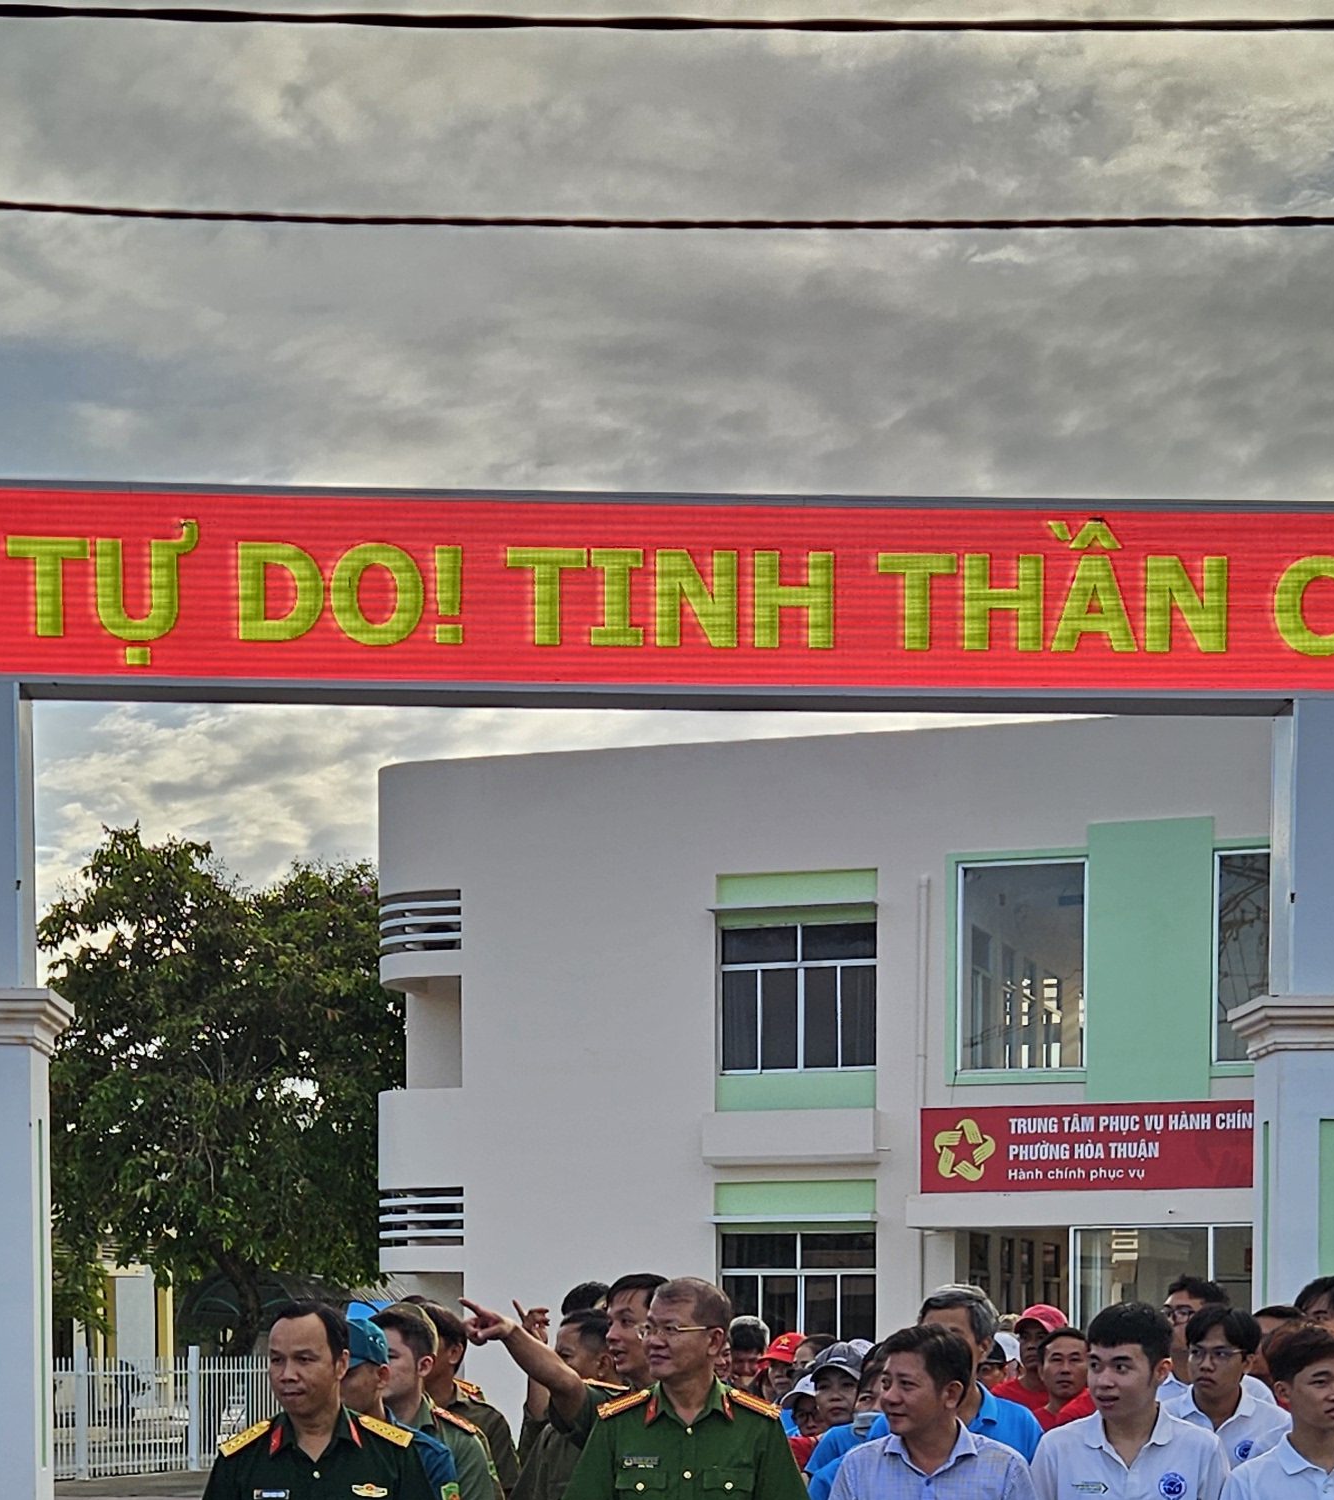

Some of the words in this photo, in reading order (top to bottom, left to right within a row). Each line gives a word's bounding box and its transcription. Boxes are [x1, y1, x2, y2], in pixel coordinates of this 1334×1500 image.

[6, 518, 199, 665] TỰ
[237, 541, 463, 645] DO!
[506, 546, 835, 648] TINH
[877, 517, 1228, 652] THẦN
[1009, 1117, 1058, 1134] TRUNG
[1062, 1113, 1095, 1133] TÂM
[1099, 1114, 1140, 1135] PHỤC
[1144, 1114, 1164, 1134] VỤ
[1168, 1110, 1211, 1131] HÀNH
[1009, 1139, 1070, 1161] PHƯỜNG
[1074, 1139, 1105, 1160] HÒA
[1109, 1138, 1160, 1162] THUẬN
[1008, 1168, 1043, 1181] Hành
[1047, 1166, 1086, 1180] chính
[1090, 1167, 1124, 1181] phục
[1128, 1168, 1145, 1181] vụ
